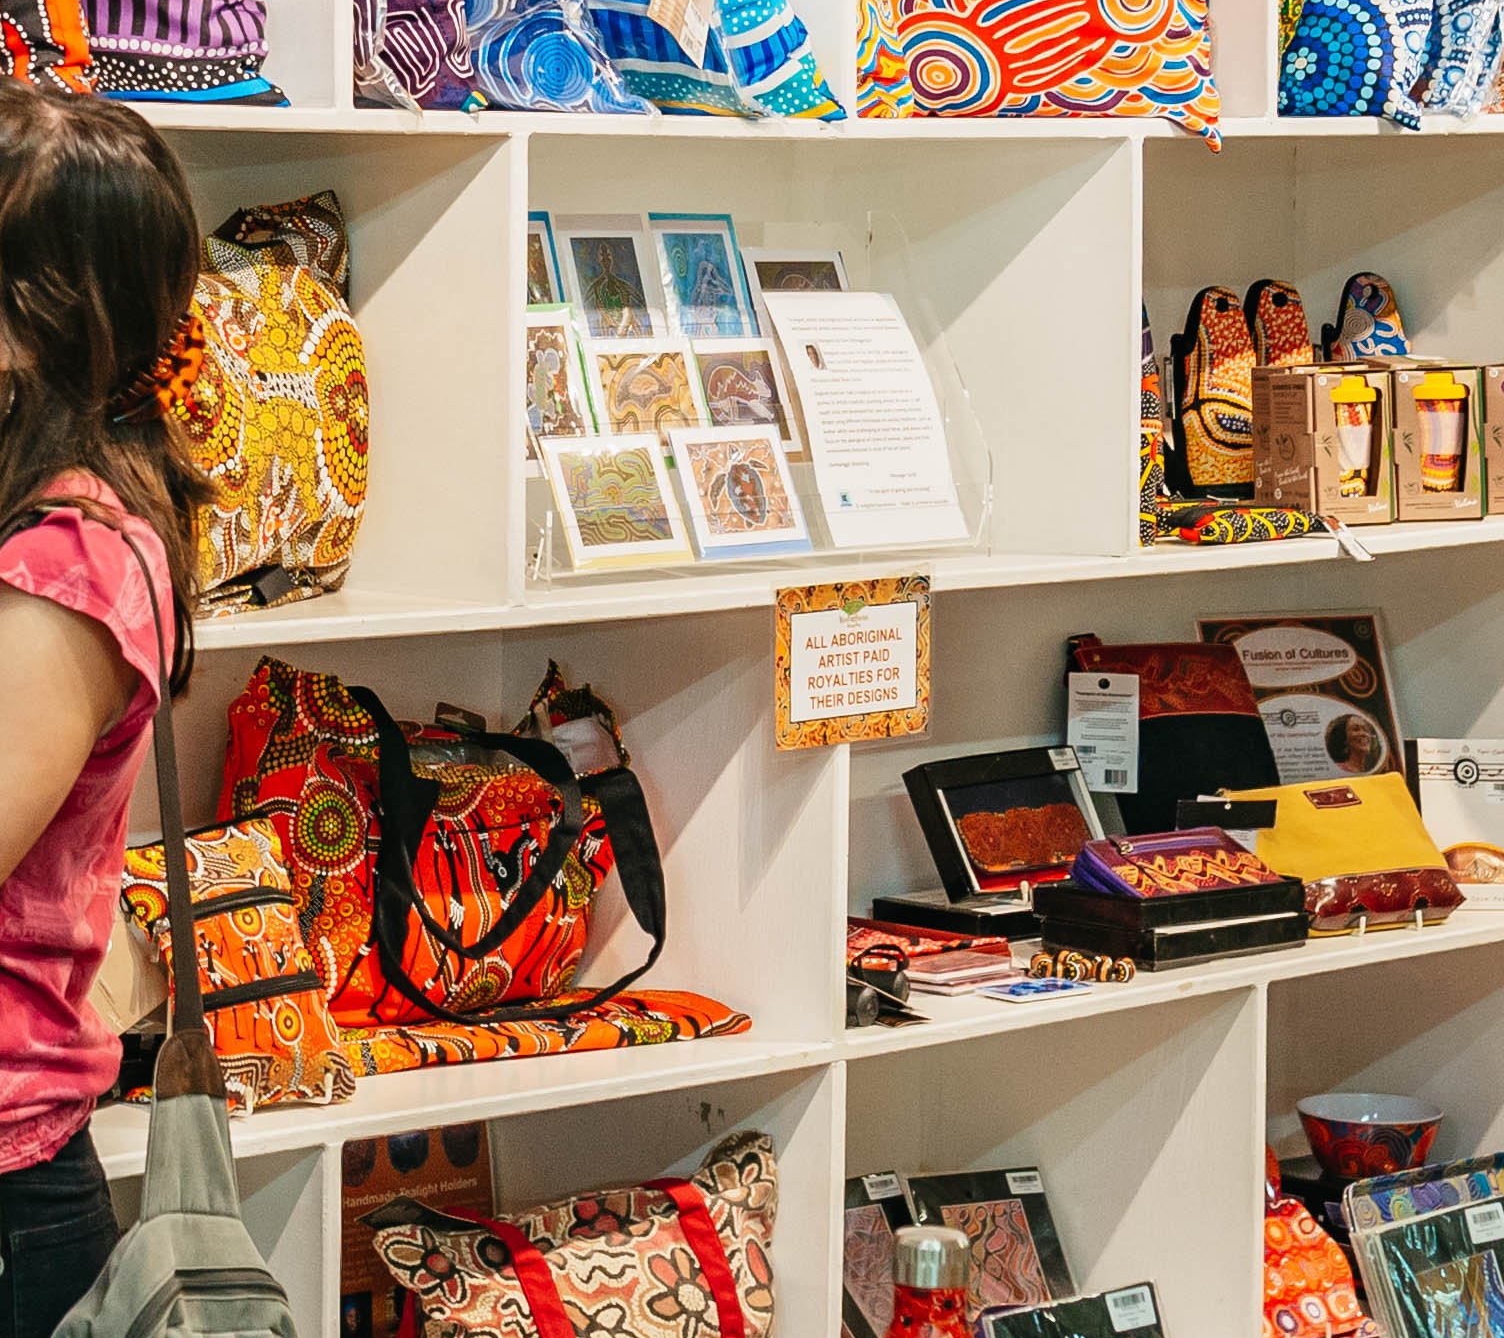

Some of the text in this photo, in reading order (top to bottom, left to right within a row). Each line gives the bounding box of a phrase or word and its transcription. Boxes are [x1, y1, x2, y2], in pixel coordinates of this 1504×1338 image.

[805, 628, 903, 651] ALL ABORIGINAL
[818, 649, 890, 670] ARTIST PAID
[1242, 647, 1350, 662] Fusion of Cultures
[808, 667, 901, 691] ROYALTIES FOR
[809, 687, 899, 710] THEIR DESIGNS
[399, 1183, 439, 1199] Tealight
[440, 1176, 478, 1192] Holders
